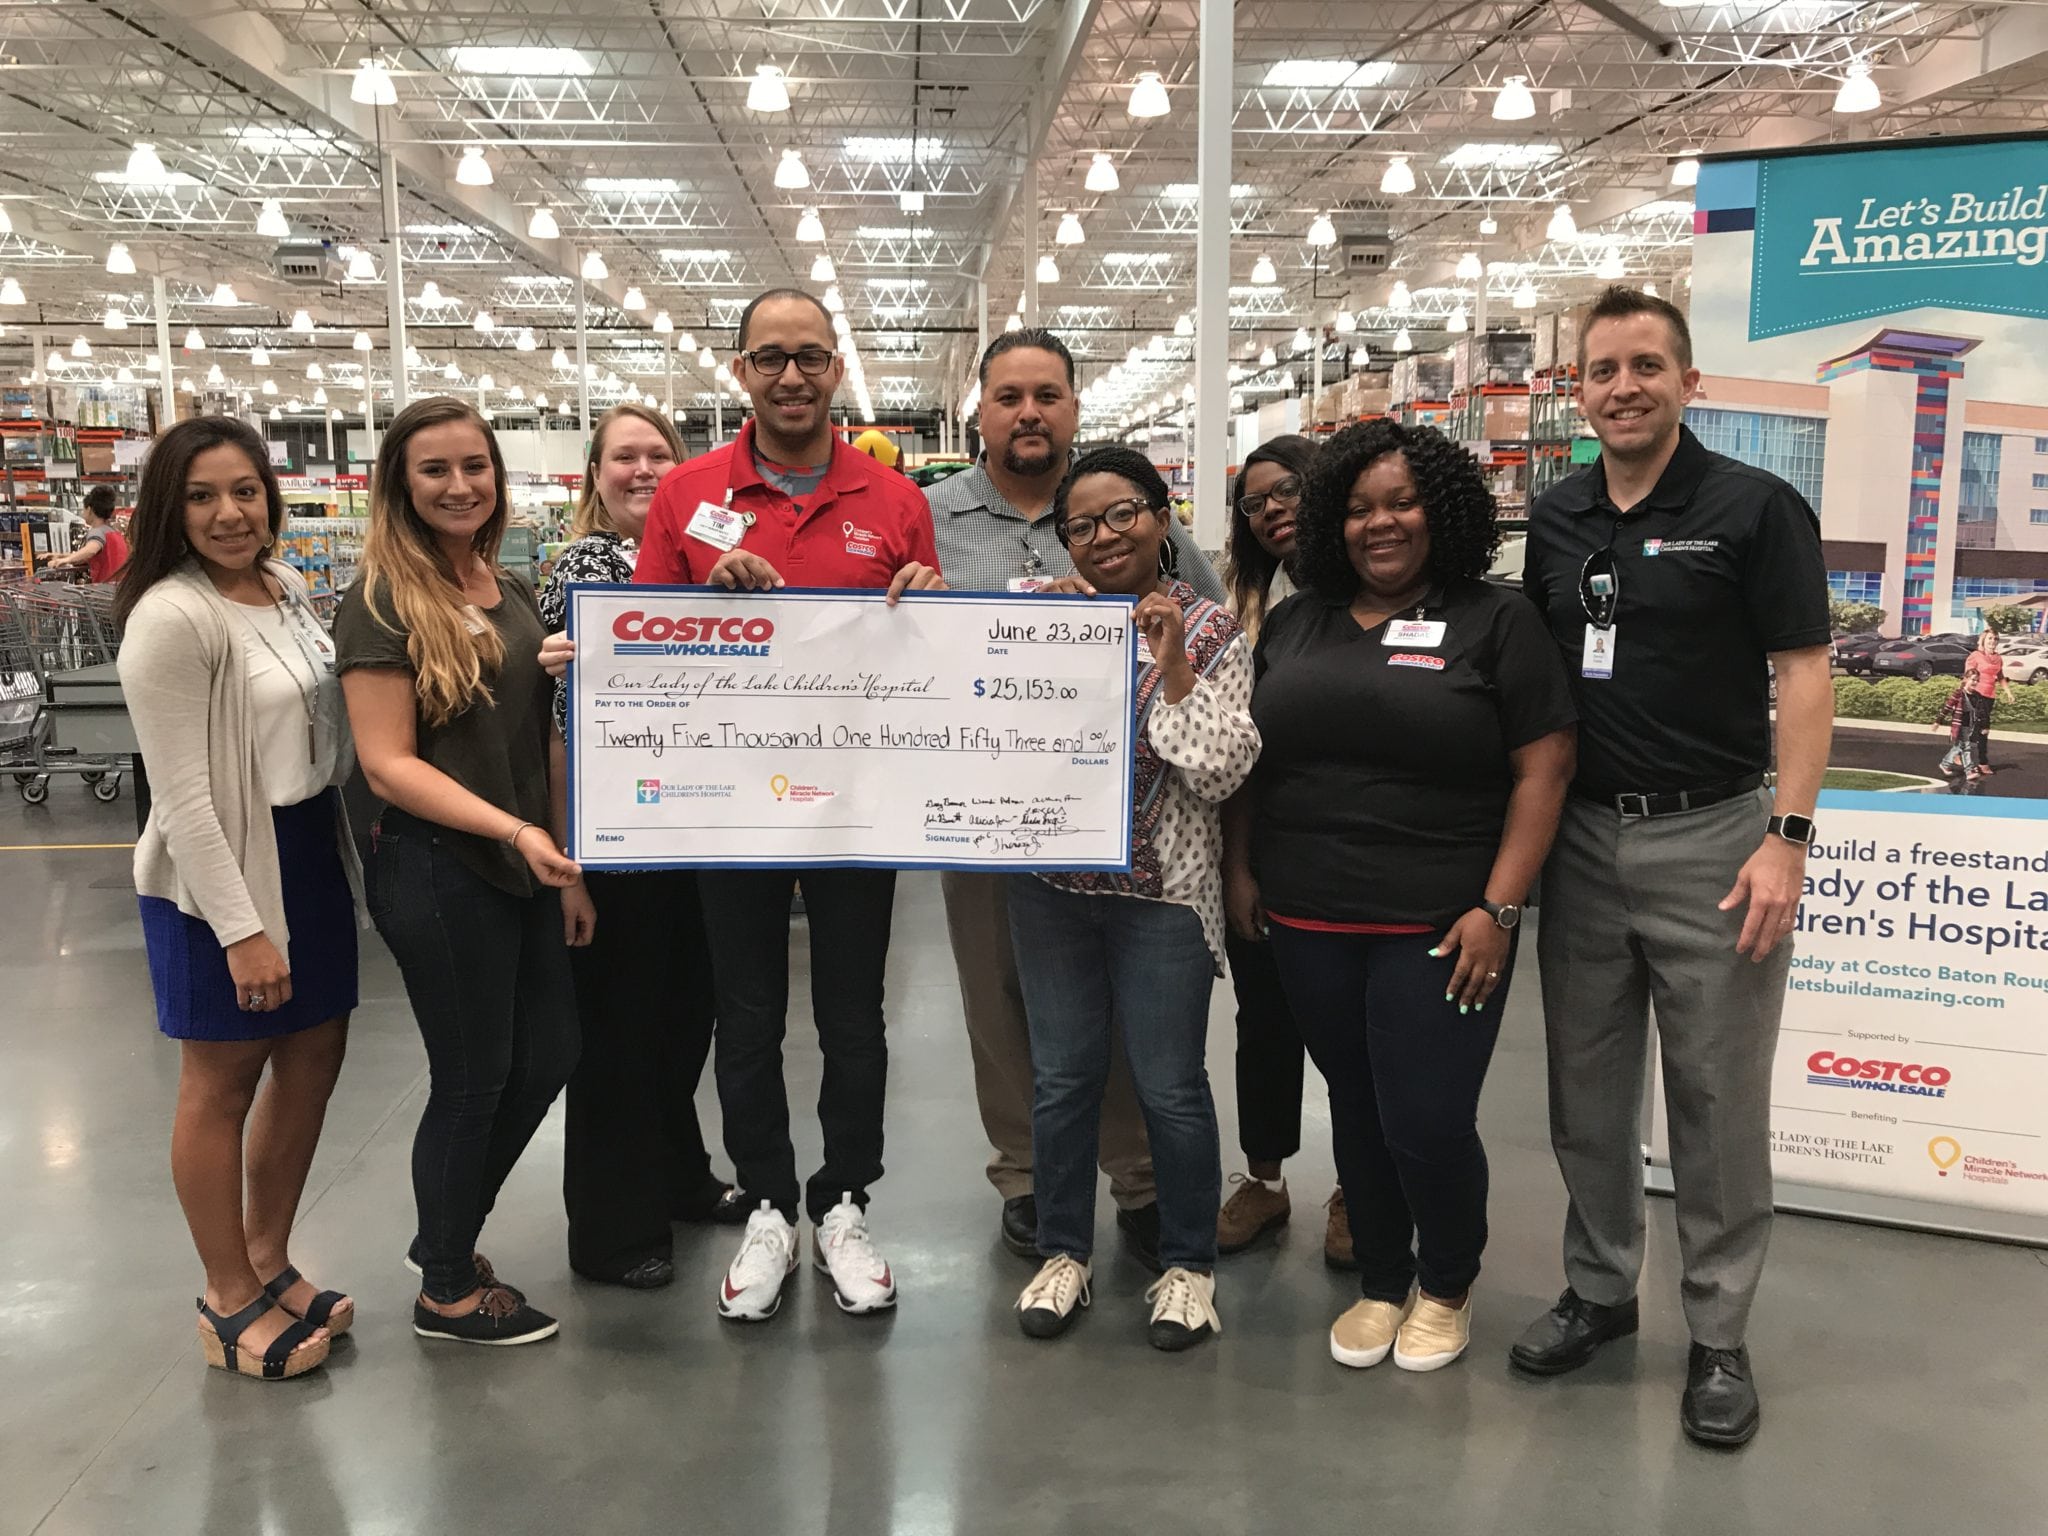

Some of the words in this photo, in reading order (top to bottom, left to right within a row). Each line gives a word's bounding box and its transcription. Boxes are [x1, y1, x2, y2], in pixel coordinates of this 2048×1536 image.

[1854, 197, 1941, 229] Let's
[1944, 185, 2048, 225] Build
[1799, 217, 2048, 266] Amazing
[1531, 378, 1551, 393] 304
[58, 427, 74, 438] 108
[712, 520, 725, 530] TIM
[612, 610, 774, 643] COSTCO
[988, 618, 1038, 642] June
[663, 643, 770, 657] WHOLESALE
[987, 647, 1009, 655] DATE
[1391, 654, 1444, 666] COSTCO
[607, 673, 643, 690] Our
[648, 672, 692, 699] Lady
[694, 672, 714, 699] of
[715, 674, 739, 691] the
[742, 673, 780, 691] Lake
[783, 673, 859, 692] Children's
[858, 672, 935, 702] Hospital
[595, 699, 612, 708] PAY
[614, 700, 626, 708] TO
[628, 700, 644, 708] THE
[646, 699, 677, 708] ORDER
[679, 700, 690, 708] OF
[594, 720, 664, 758] Twenty
[672, 722, 714, 748] Five
[718, 722, 822, 748] Thousand
[832, 725, 872, 748] One
[880, 724, 951, 749] Hundred
[960, 726, 1001, 760] Fifty
[1004, 729, 1046, 752] Three
[1053, 731, 1084, 752] and
[1071, 757, 1109, 765] DOLLARS
[701, 790, 732, 798] HOSPITAL
[595, 834, 625, 842] MEMO
[925, 833, 970, 844] SIGNATURE
[1808, 839, 1876, 862] build
[1885, 848, 1901, 863] a
[1910, 842, 2048, 873] freestand
[1802, 868, 1865, 906] ady
[1877, 872, 1917, 902] of
[1926, 875, 1990, 908] the
[2006, 881, 2048, 912] La
[1790, 955, 1836, 975] oday
[1840, 959, 1860, 973] at
[1865, 960, 1932, 979] Costco
[1938, 966, 1997, 985] Baton
[1788, 975, 2005, 1008] letsbuildamazing.com
[1847, 1029, 1896, 1043] Supported
[1898, 1034, 1910, 1044] by
[1807, 1051, 1951, 1087] COSTCO
[1849, 1079, 1947, 1098] WHOLESALE
[1851, 1111, 1898, 1124] Benefiting
[1780, 1131, 1813, 1144] LADY
[1814, 1135, 1830, 1146] OF
[1833, 1138, 1858, 1150] THE
[1861, 1140, 1895, 1154] LAKE
[1824, 1148, 1886, 1165] HOSPITAL
[1964, 1155, 2017, 1169] Children's
[1962, 1172, 2009, 1185] Hospitals
[1963, 1164, 2004, 1176] Miracle
[2005, 1169, 2048, 1181] Network
